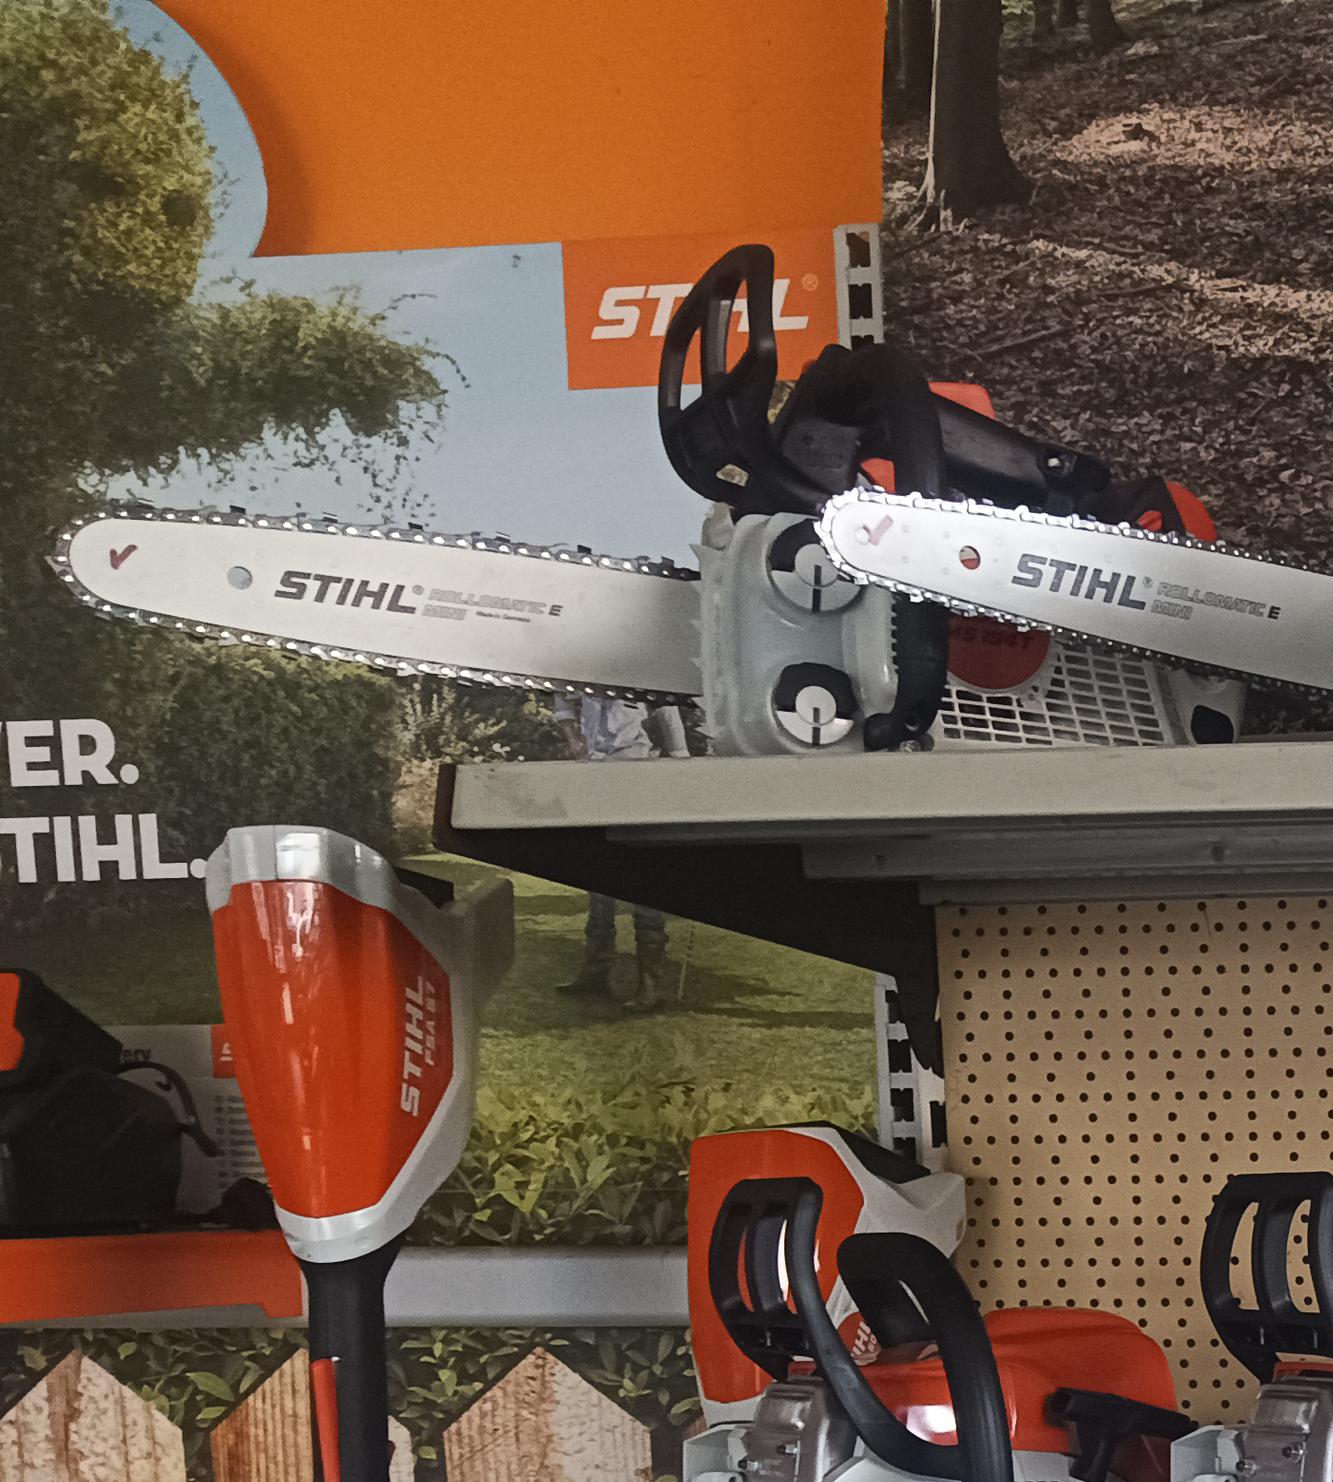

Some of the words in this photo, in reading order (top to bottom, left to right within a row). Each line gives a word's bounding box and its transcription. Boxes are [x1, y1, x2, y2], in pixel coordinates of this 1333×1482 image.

[590, 277, 809, 340] STL
[274, 570, 416, 614] STIHL
[548, 604, 563, 617] E
[1011, 553, 1147, 610] STIHL
[1267, 606, 1282, 620] E
[0, 718, 140, 788] ER.
[0, 813, 207, 883] TIHL.
[401, 975, 425, 1117] STIHL
